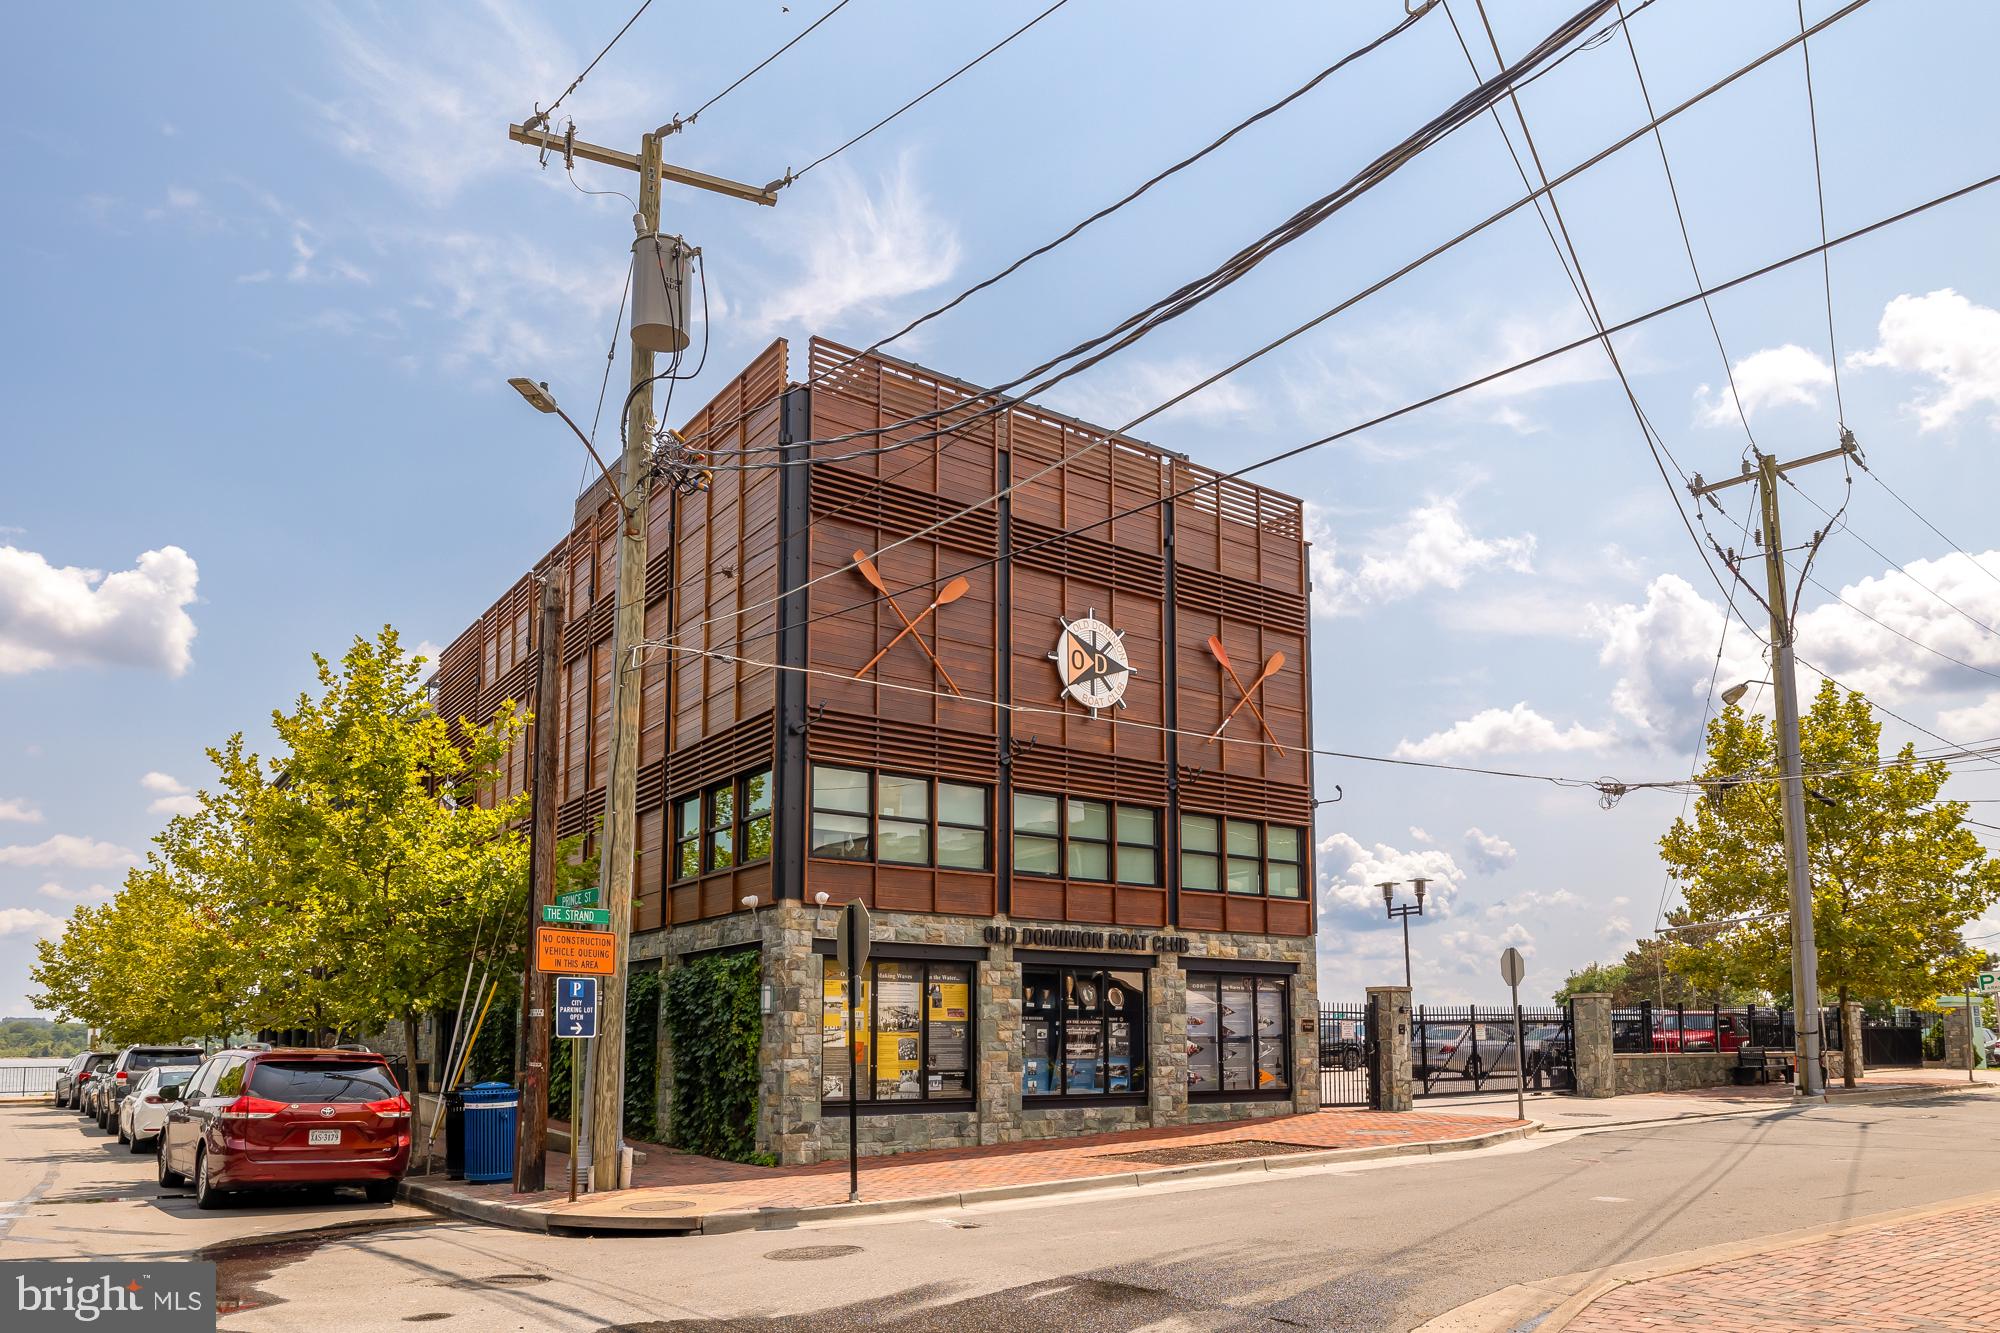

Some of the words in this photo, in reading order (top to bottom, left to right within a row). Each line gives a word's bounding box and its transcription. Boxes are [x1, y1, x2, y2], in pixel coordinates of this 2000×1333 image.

[1072, 621, 1089, 632] OLD
[1093, 621, 1126, 661] DOMINION
[1072, 649, 1084, 670] O
[1094, 653, 1108, 674] D
[1082, 694, 1104, 706] BOAT
[1108, 682, 1124, 704] CLUB
[562, 893, 582, 907] PRINCE
[584, 891, 591, 903] ST
[547, 908, 561, 920] THE
[565, 909, 594, 921] STRAND
[543, 935, 553, 943] NO
[556, 935, 611, 947] CONSTRUCTION
[983, 925, 1017, 945] OLD
[1022, 928, 1104, 949] DOMINION
[1109, 933, 1148, 951] BOAT
[1152, 935, 1190, 954] CLUB
[544, 947, 575, 957] VEHICLE
[578, 949, 609, 958] QUEUING
[554, 959, 561, 967] IN
[564, 959, 579, 968] THIS
[581, 961, 599, 969] AREA
[573, 982, 582, 996] P
